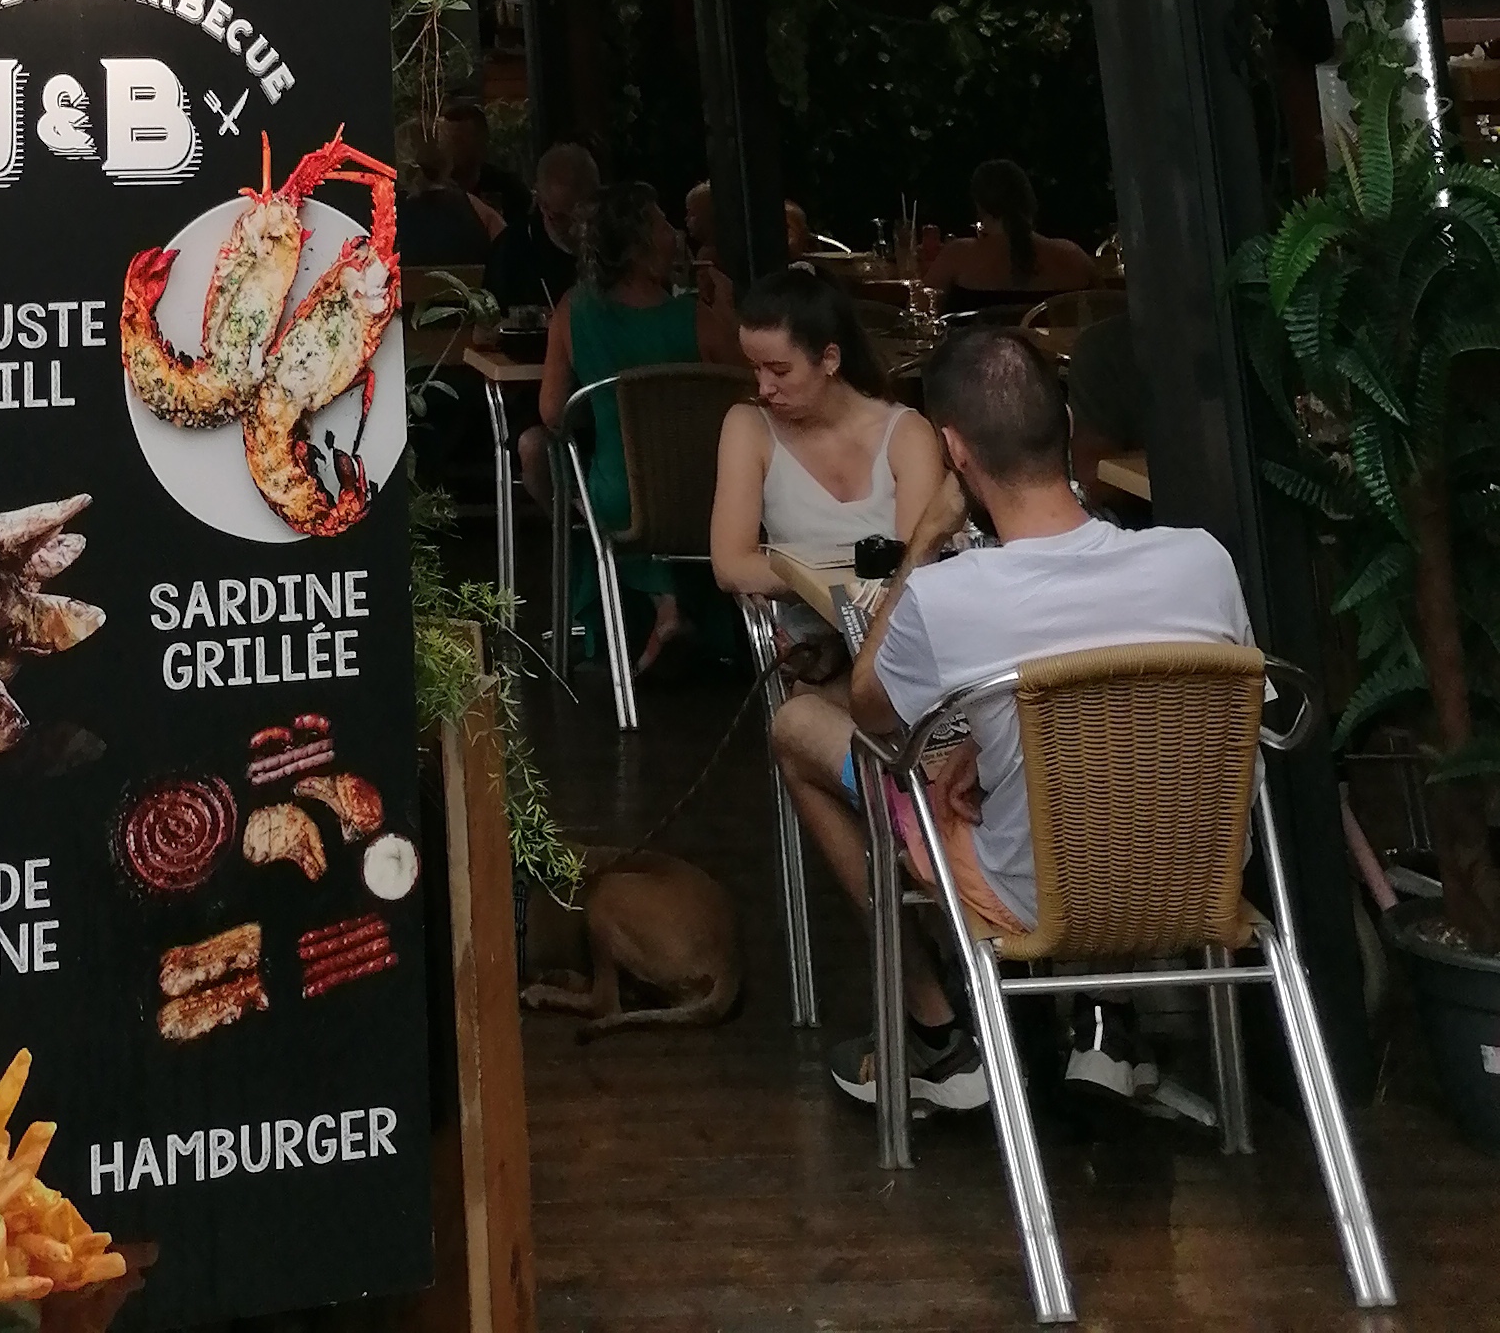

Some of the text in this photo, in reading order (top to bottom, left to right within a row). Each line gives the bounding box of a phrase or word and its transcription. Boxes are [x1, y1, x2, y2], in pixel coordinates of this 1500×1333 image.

[149, 570, 370, 631] SARDINE
[161, 622, 361, 692] GRILLÉE
[88, 1106, 398, 1197] HAMBURGER
